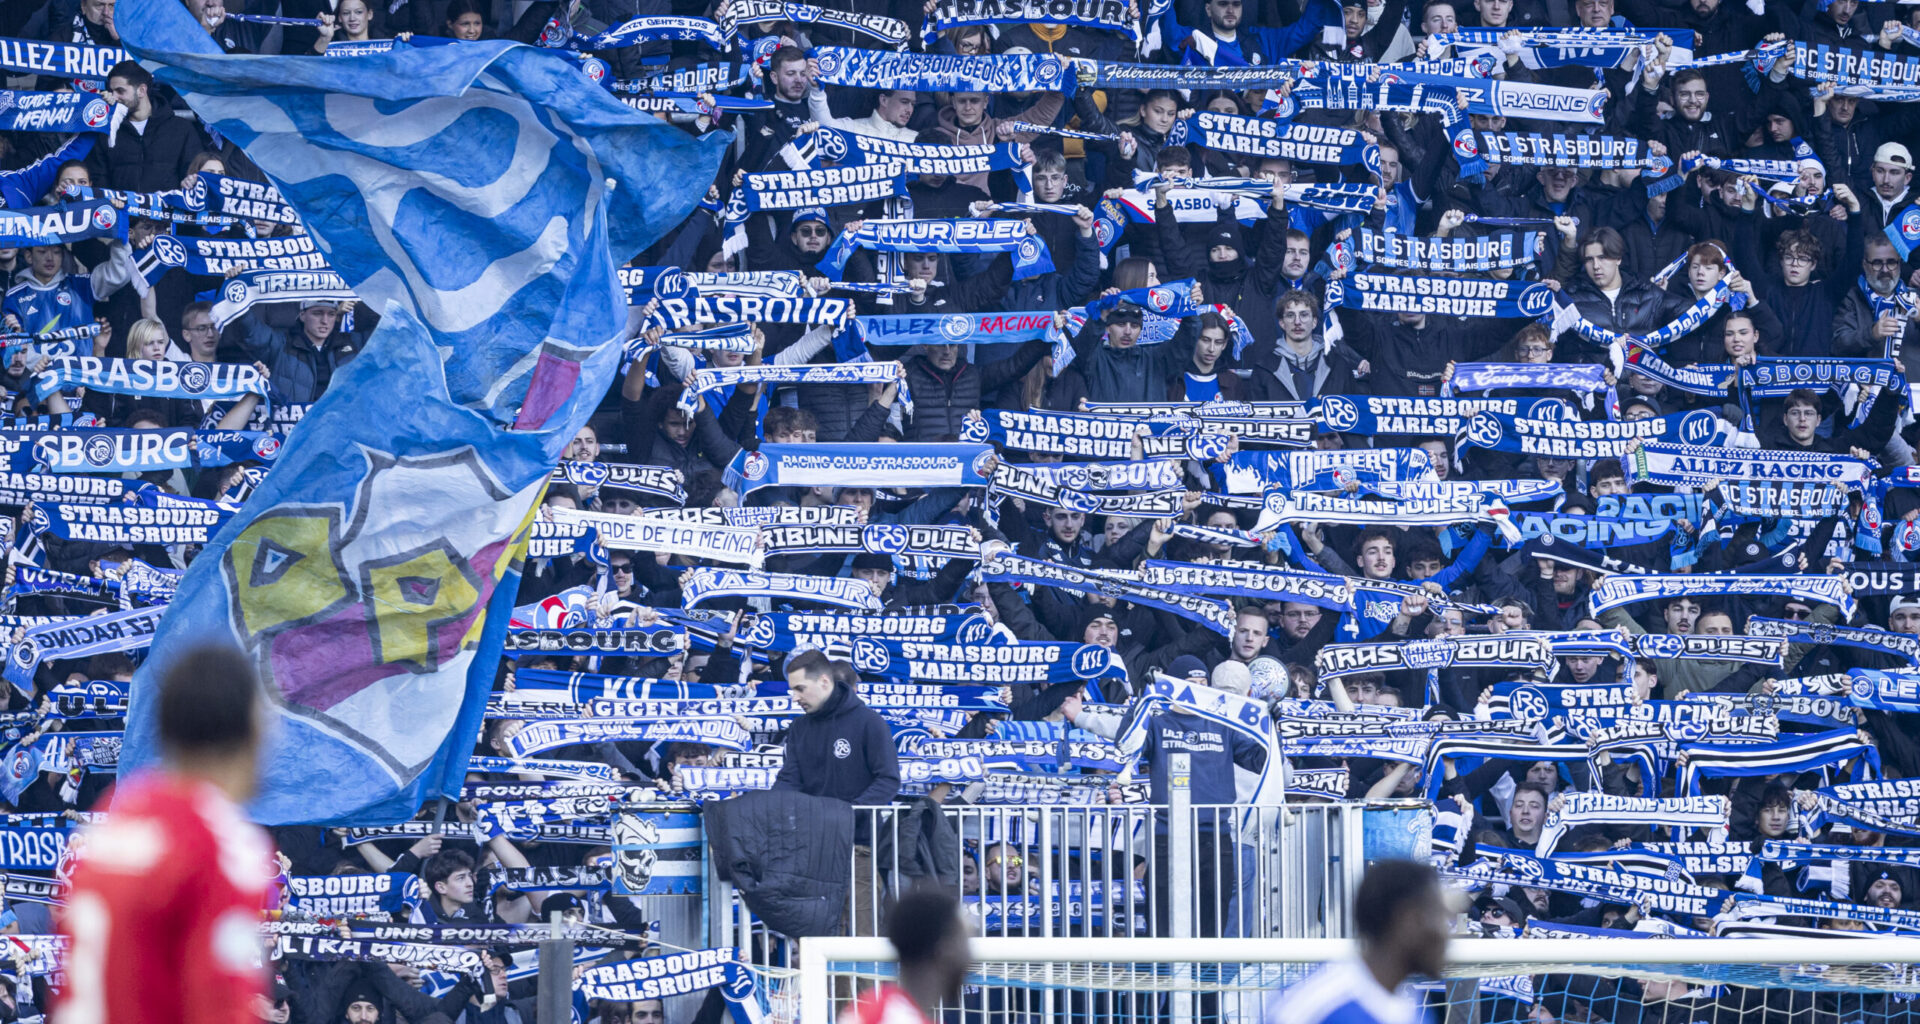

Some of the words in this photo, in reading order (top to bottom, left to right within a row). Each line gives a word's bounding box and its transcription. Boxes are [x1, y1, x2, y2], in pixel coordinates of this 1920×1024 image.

[647, 18, 686, 30] GEHT'S
[0, 43, 56, 73] LLEZ
[64, 49, 134, 77] RACI
[868, 55, 1004, 88] STRASBOURGEOIS
[1797, 48, 1818, 69] RC
[1824, 52, 1920, 84] STRASBOU
[1103, 62, 1180, 82] Fédération
[1184, 65, 1206, 80] des
[1214, 62, 1292, 84] Supporters
[18, 94, 52, 108] STADE
[56, 93, 71, 105] DE
[620, 97, 680, 112] MOUR.
[1459, 86, 1485, 103] EZ
[1502, 92, 1588, 112] RACING
[13, 107, 73, 130] MEINAU
[1198, 113, 1356, 147] STRASBOURG
[856, 134, 996, 159] STRASBOURG
[1205, 131, 1343, 163] KARLSRUHE
[1484, 134, 1510, 152] RC
[1514, 136, 1638, 157] STRASBOURG
[1503, 156, 1536, 165] SOMMES
[1538, 158, 1553, 166] PAS
[1584, 159, 1604, 167] MAIS
[1606, 160, 1620, 168] DES
[749, 163, 902, 191] STRASBOURG
[219, 178, 284, 202] STRA
[759, 180, 894, 210] KARLSRUHE
[128, 206, 151, 217] MMES
[222, 197, 300, 223] KARLS
[882, 219, 947, 238] MUR
[955, 220, 1028, 239] BLEU
[197, 236, 316, 261] STRASBOU
[1361, 235, 1385, 253] RC
[1391, 237, 1511, 260] STRASBOURG
[1376, 256, 1409, 266] SOMMES
[1411, 260, 1427, 270] PAS
[1459, 261, 1478, 270] MAIS
[1480, 260, 1495, 269] DES
[255, 273, 350, 292] TRIBUN
[1354, 273, 1508, 299] STRASBOURG
[1362, 292, 1497, 317] KARLSRUHE
[866, 316, 934, 337] ALLEZ
[979, 314, 1052, 334] RACING
[1641, 353, 1714, 387] KARLSRUHE
[1368, 396, 1517, 416] STRASBOURG
[1000, 411, 1149, 439] STRASBOURG
[1514, 417, 1667, 439] STRASBOURG
[41, 430, 189, 468] SBOURG
[1005, 430, 1133, 458] KARLSRUH
[1143, 437, 1183, 455] INE
[782, 454, 831, 470] RACING
[833, 455, 868, 469] CLUB
[869, 455, 959, 470] STRASBOURG
[1681, 450, 1722, 459] RACING
[1726, 452, 1753, 460] CLUB
[1758, 454, 1831, 462] STRASBOURG
[1109, 460, 1178, 487] BOYS
[1670, 457, 1745, 477] ALLEZ
[1750, 462, 1845, 480] RACING
[0, 473, 123, 496] RASBOURG
[1719, 482, 1741, 501] RC
[1746, 486, 1850, 507] STRASBOUR
[59, 504, 219, 526] STRASBOURG
[68, 523, 208, 544] KARLSRUHE
[642, 525, 665, 542] DE
[670, 527, 693, 544] LA
[762, 525, 860, 547] RIBUNE
[911, 528, 981, 552] OUES
[1521, 514, 1673, 546] ACING
[1851, 571, 1904, 591] OUS
[788, 614, 946, 636] STRASBOURG
[505, 629, 677, 652] ASBOURG
[902, 641, 1061, 664] STRASBOURG
[909, 660, 1050, 683] KARLSRUHE
[857, 694, 959, 707] SBOURG
[877, 685, 919, 695] CLUB
[923, 686, 943, 696] DE
[1560, 688, 1635, 708] STRAS
[595, 702, 661, 717] GEGEN
[293, 874, 391, 897] SBOURG
[1555, 861, 1719, 898] STRASBOURG
[294, 894, 381, 915] SRUHE
[1649, 894, 1708, 916] RUHE
[1785, 904, 1840, 918] VEREINT
[258, 920, 323, 936] SBOURG
[375, 927, 433, 941] UNIS
[441, 927, 509, 941] POUR
[581, 947, 734, 986] TRASBOURG
[582, 966, 727, 1001] KARLSRUHE
